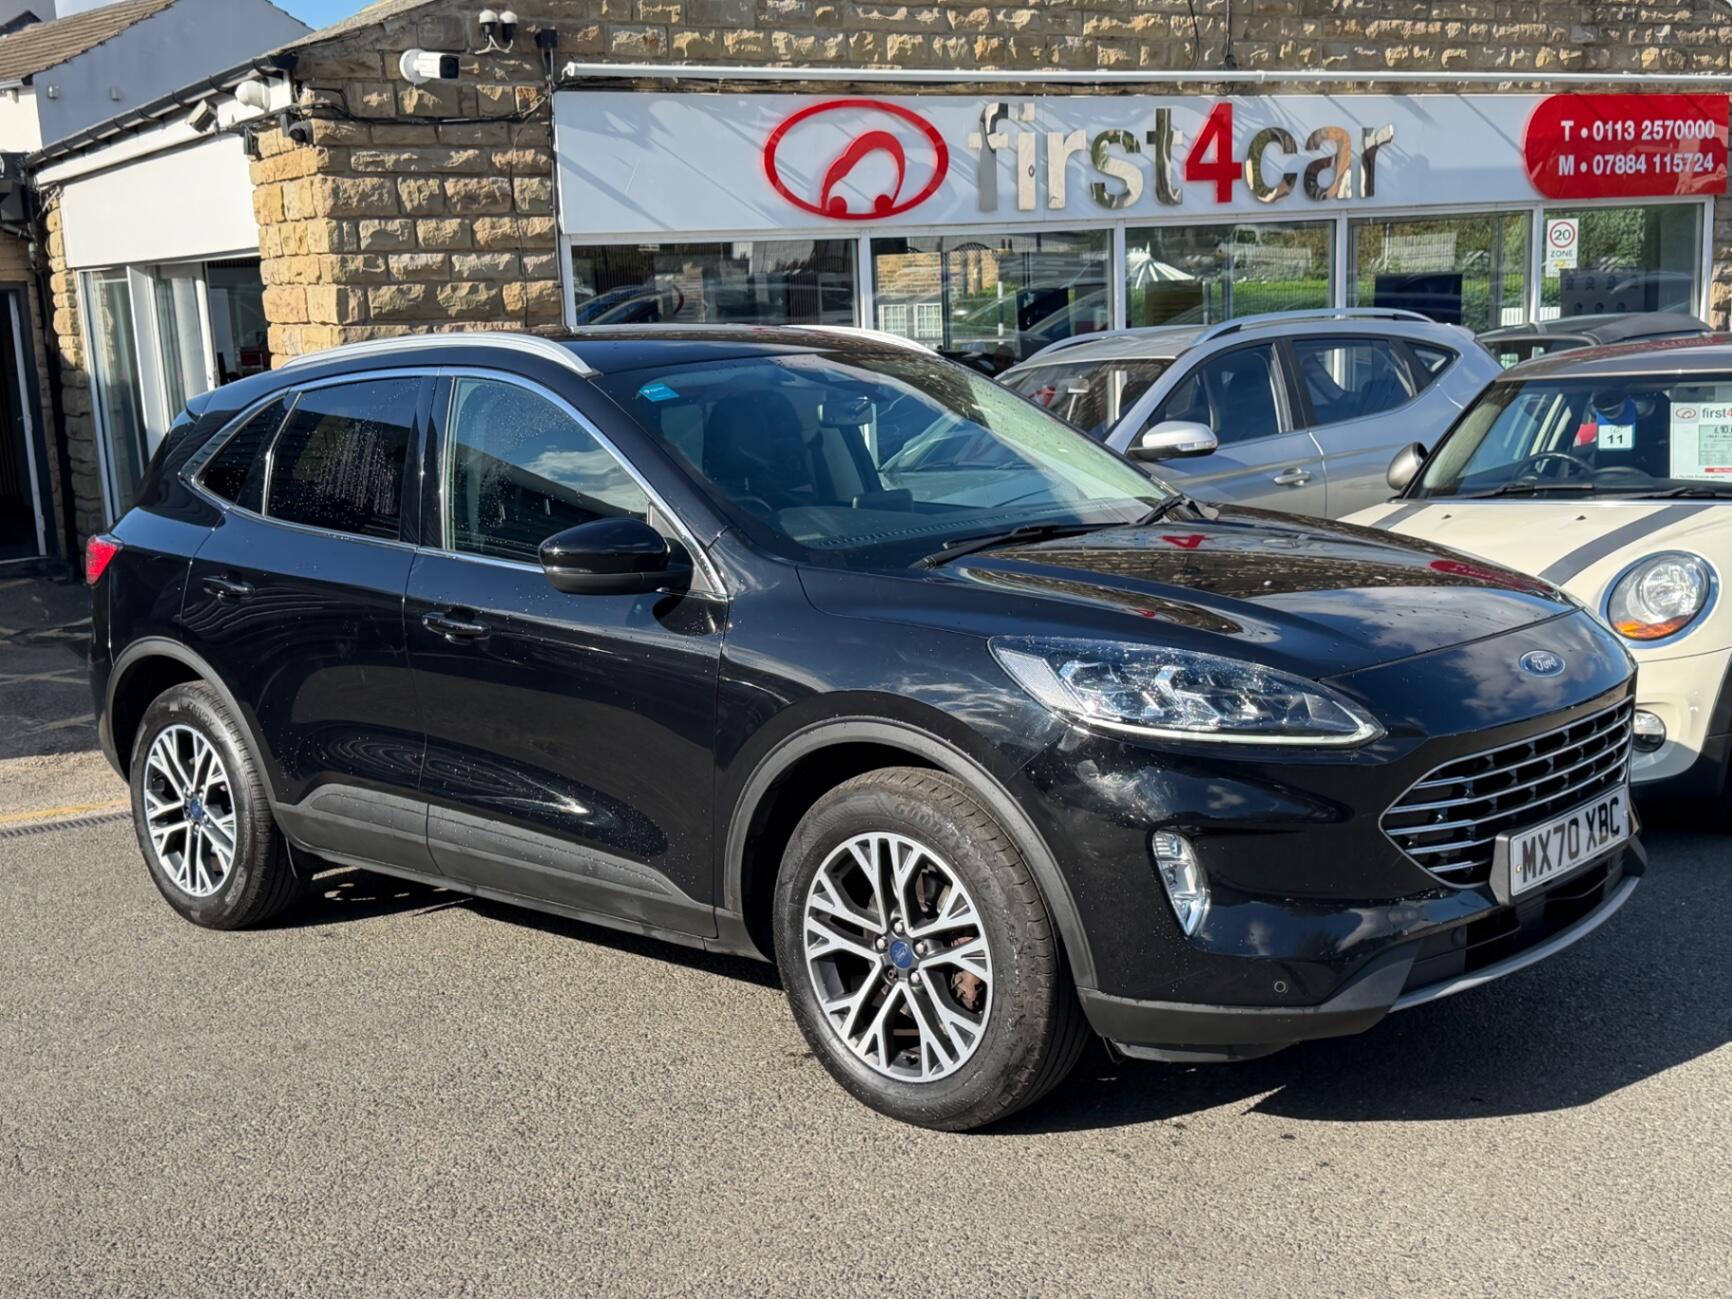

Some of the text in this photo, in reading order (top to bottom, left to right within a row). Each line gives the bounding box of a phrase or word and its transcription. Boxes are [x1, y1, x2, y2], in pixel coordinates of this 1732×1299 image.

[1560, 119, 1716, 142] T 0113 2570000
[968, 101, 1394, 212] first4car
[1557, 152, 1714, 177] M 07884 115724
[1553, 229, 1571, 241] 20
[1550, 250, 1574, 258] ZONE
[1607, 434, 1623, 444] 11
[1531, 655, 1558, 671] Ford
[1522, 796, 1621, 883] MX70 XBC
